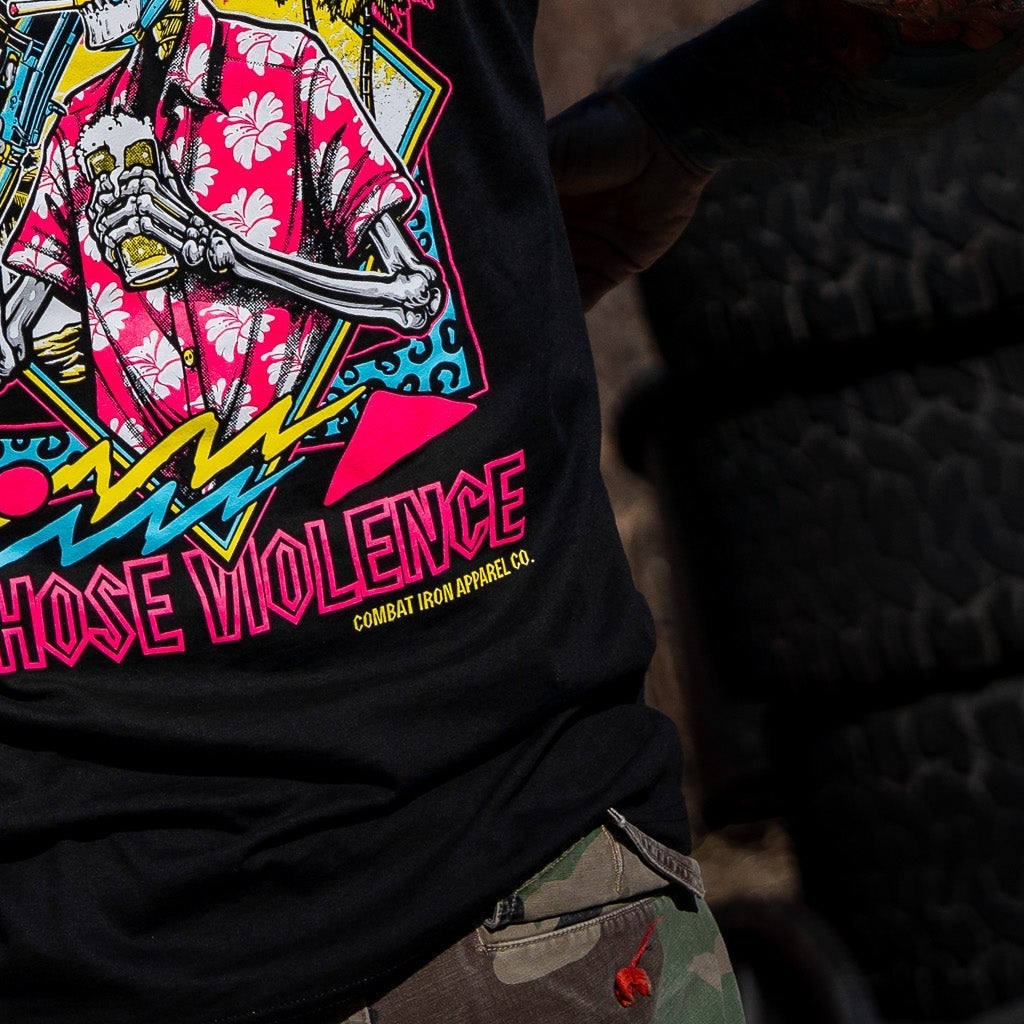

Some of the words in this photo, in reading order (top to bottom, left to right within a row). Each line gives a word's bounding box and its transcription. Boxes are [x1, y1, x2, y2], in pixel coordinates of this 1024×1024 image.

[181, 449, 525, 644] VIOLENCE
[353, 595, 414, 632] COMBAT
[417, 582, 455, 611] IRON
[456, 557, 512, 598] APPAREL
[510, 549, 535, 570] CO.
